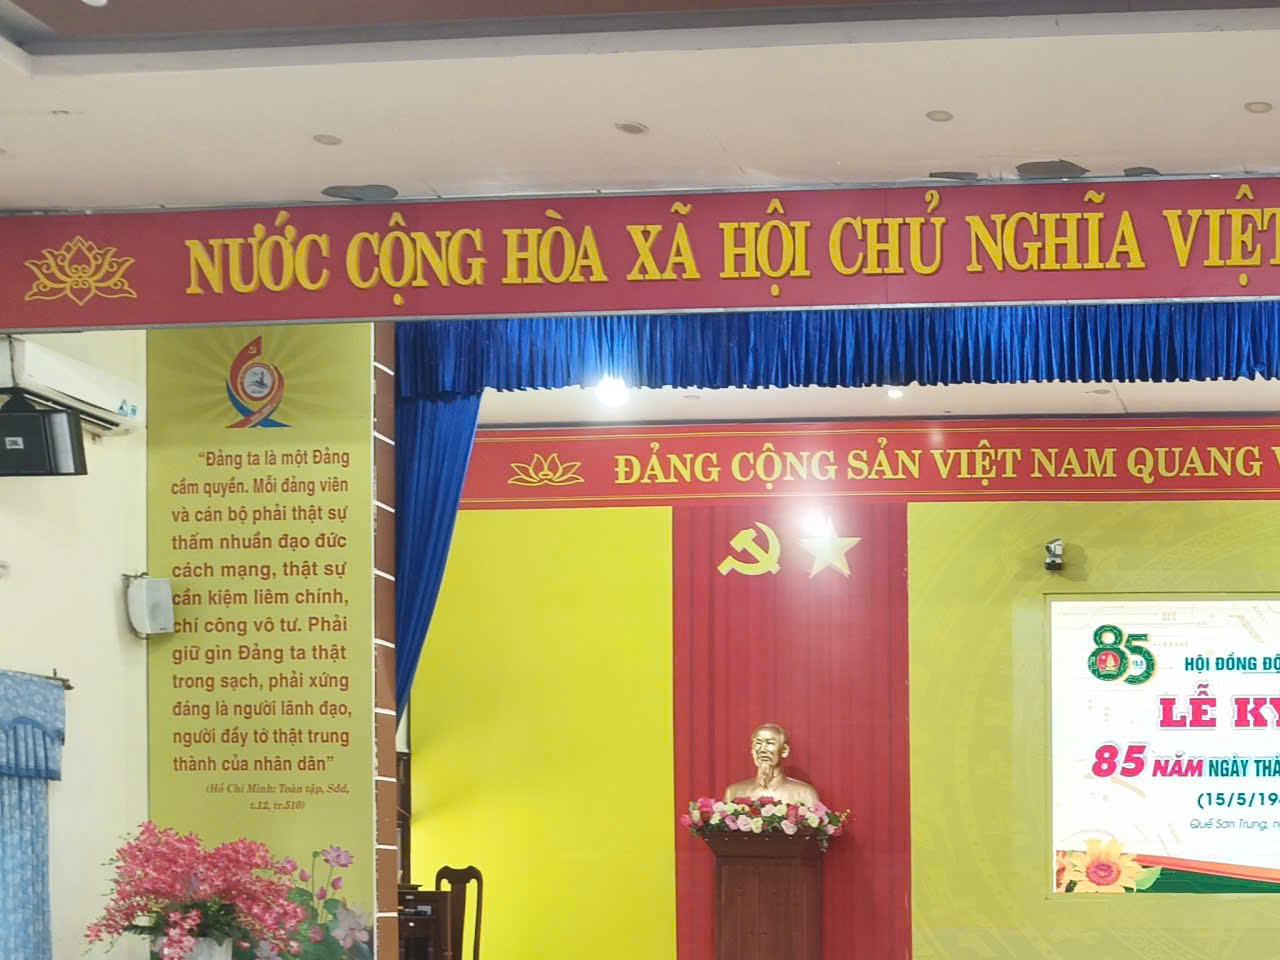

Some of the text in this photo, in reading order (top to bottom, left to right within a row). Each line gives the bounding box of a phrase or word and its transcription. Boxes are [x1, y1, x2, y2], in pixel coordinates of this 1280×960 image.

[185, 211, 331, 295] NƯỚC
[346, 212, 487, 306] CỘNG
[502, 208, 608, 286] HÒA
[625, 202, 700, 281] XÃ
[720, 199, 811, 296] HỘI
[828, 190, 947, 275] CHỦ
[966, 190, 1146, 273] NGHĨA
[246, 451, 260, 465] ta
[265, 450, 276, 465] là
[281, 449, 308, 468] một
[312, 447, 350, 468] Đảng
[614, 442, 721, 484] ĐẢNG
[731, 442, 838, 490] CỘNG
[847, 437, 922, 480] SẢN
[930, 439, 1022, 487] VIỆT
[1030, 448, 1117, 478] NAM
[1126, 446, 1263, 484] QUANG
[253, 475, 277, 493] Mỗi
[281, 475, 315, 496] đảng
[320, 476, 348, 492] viên
[172, 531, 347, 552] thấm nhuần đạo đức
[172, 560, 347, 580] cách mạng, thật sự
[173, 587, 348, 608] cần kiệm liêm chính,
[172, 643, 346, 665] giữ gìn Đảng ta thật
[1185, 654, 1210, 674] HỘI
[1215, 652, 1257, 671] ĐỒNG
[172, 670, 349, 692] trong sạch, phải xứng
[1159, 683, 1216, 728] LỄ
[173, 756, 216, 771] thành
[222, 754, 248, 771] của
[254, 756, 292, 771] nhân
[1091, 744, 1147, 777] 85
[1152, 754, 1204, 777] NĂM
[1208, 756, 1249, 777] NGÀY
